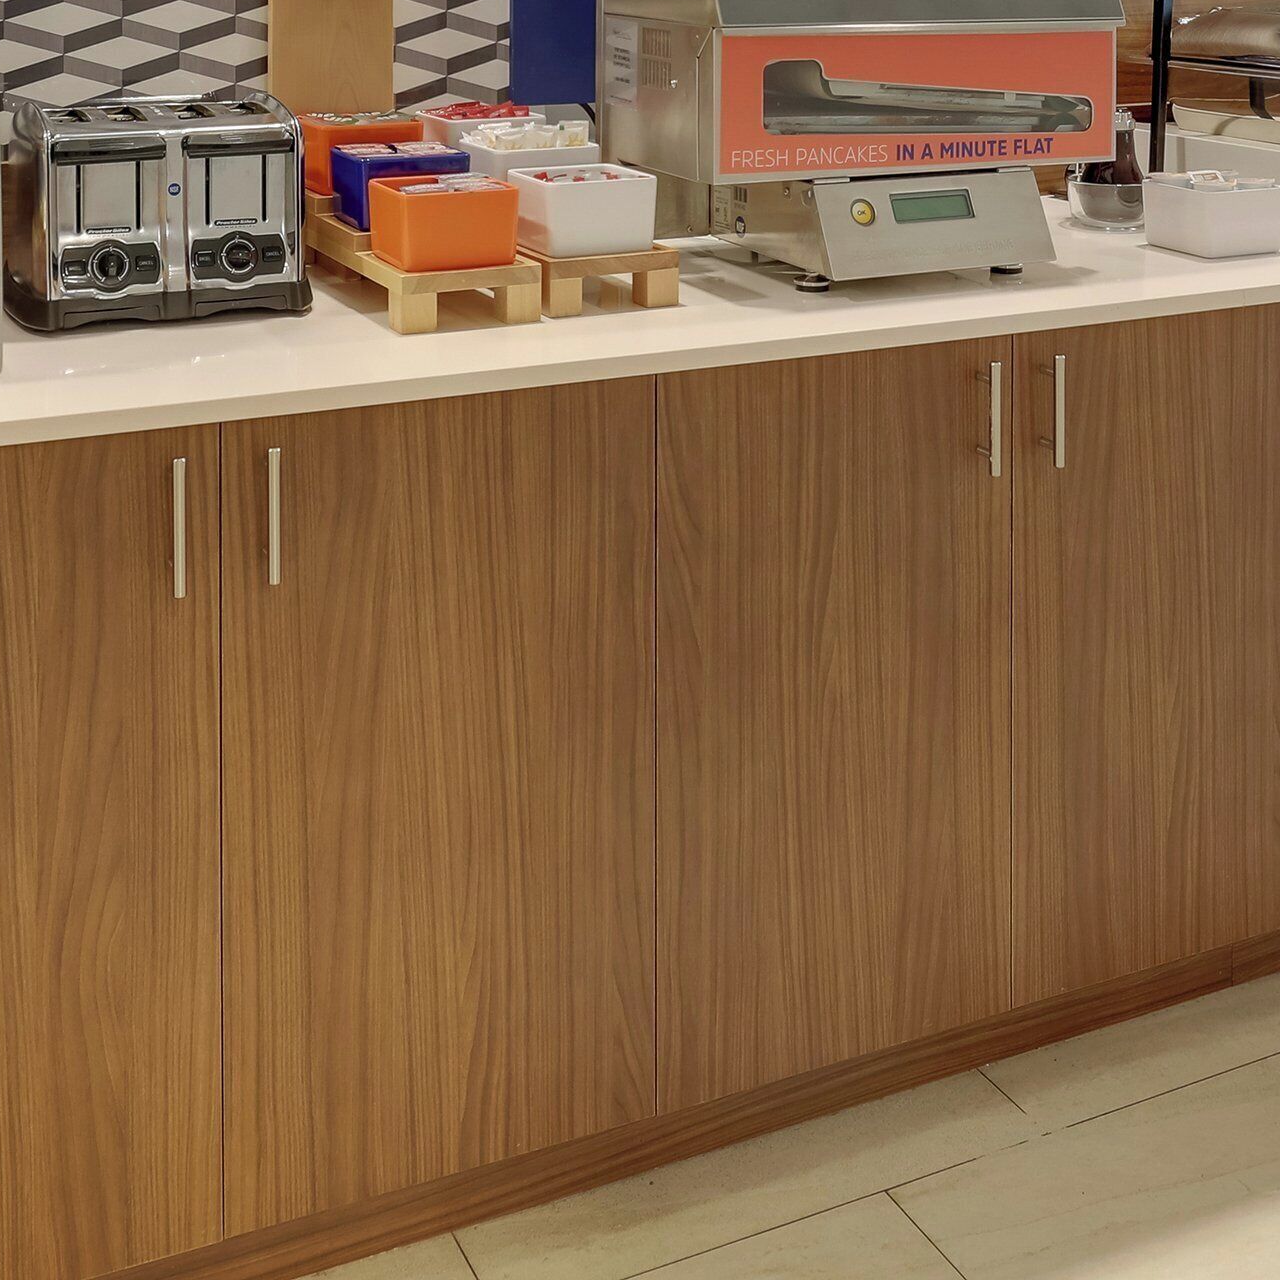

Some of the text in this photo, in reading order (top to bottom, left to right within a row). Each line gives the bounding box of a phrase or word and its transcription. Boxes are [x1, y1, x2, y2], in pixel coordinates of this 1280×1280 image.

[730, 136, 1055, 169] FRESH PANCAKES IN A MINUTE FLAT
